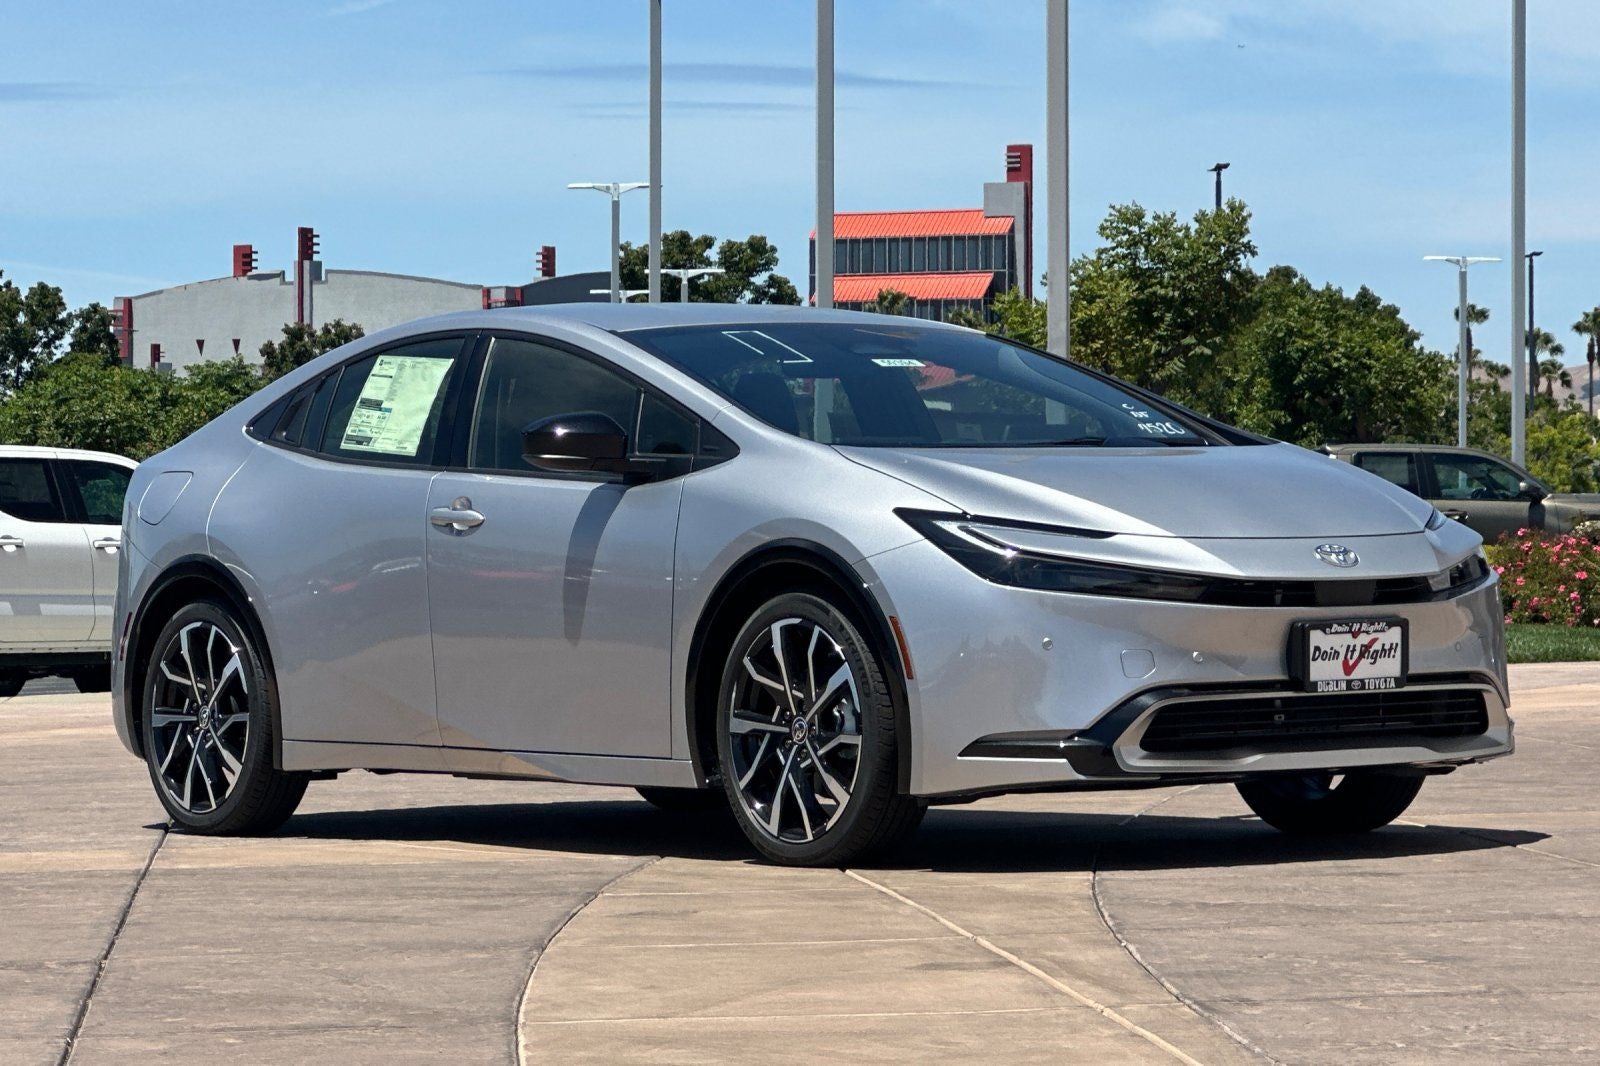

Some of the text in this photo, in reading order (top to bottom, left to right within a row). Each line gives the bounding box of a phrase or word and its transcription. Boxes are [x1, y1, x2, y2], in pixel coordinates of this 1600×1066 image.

[1331, 622, 1386, 634] Doin' It Right!
[1312, 643, 1398, 665] Doin' It Right!
[1317, 678, 1396, 692] DUBLIN TOYOTA
